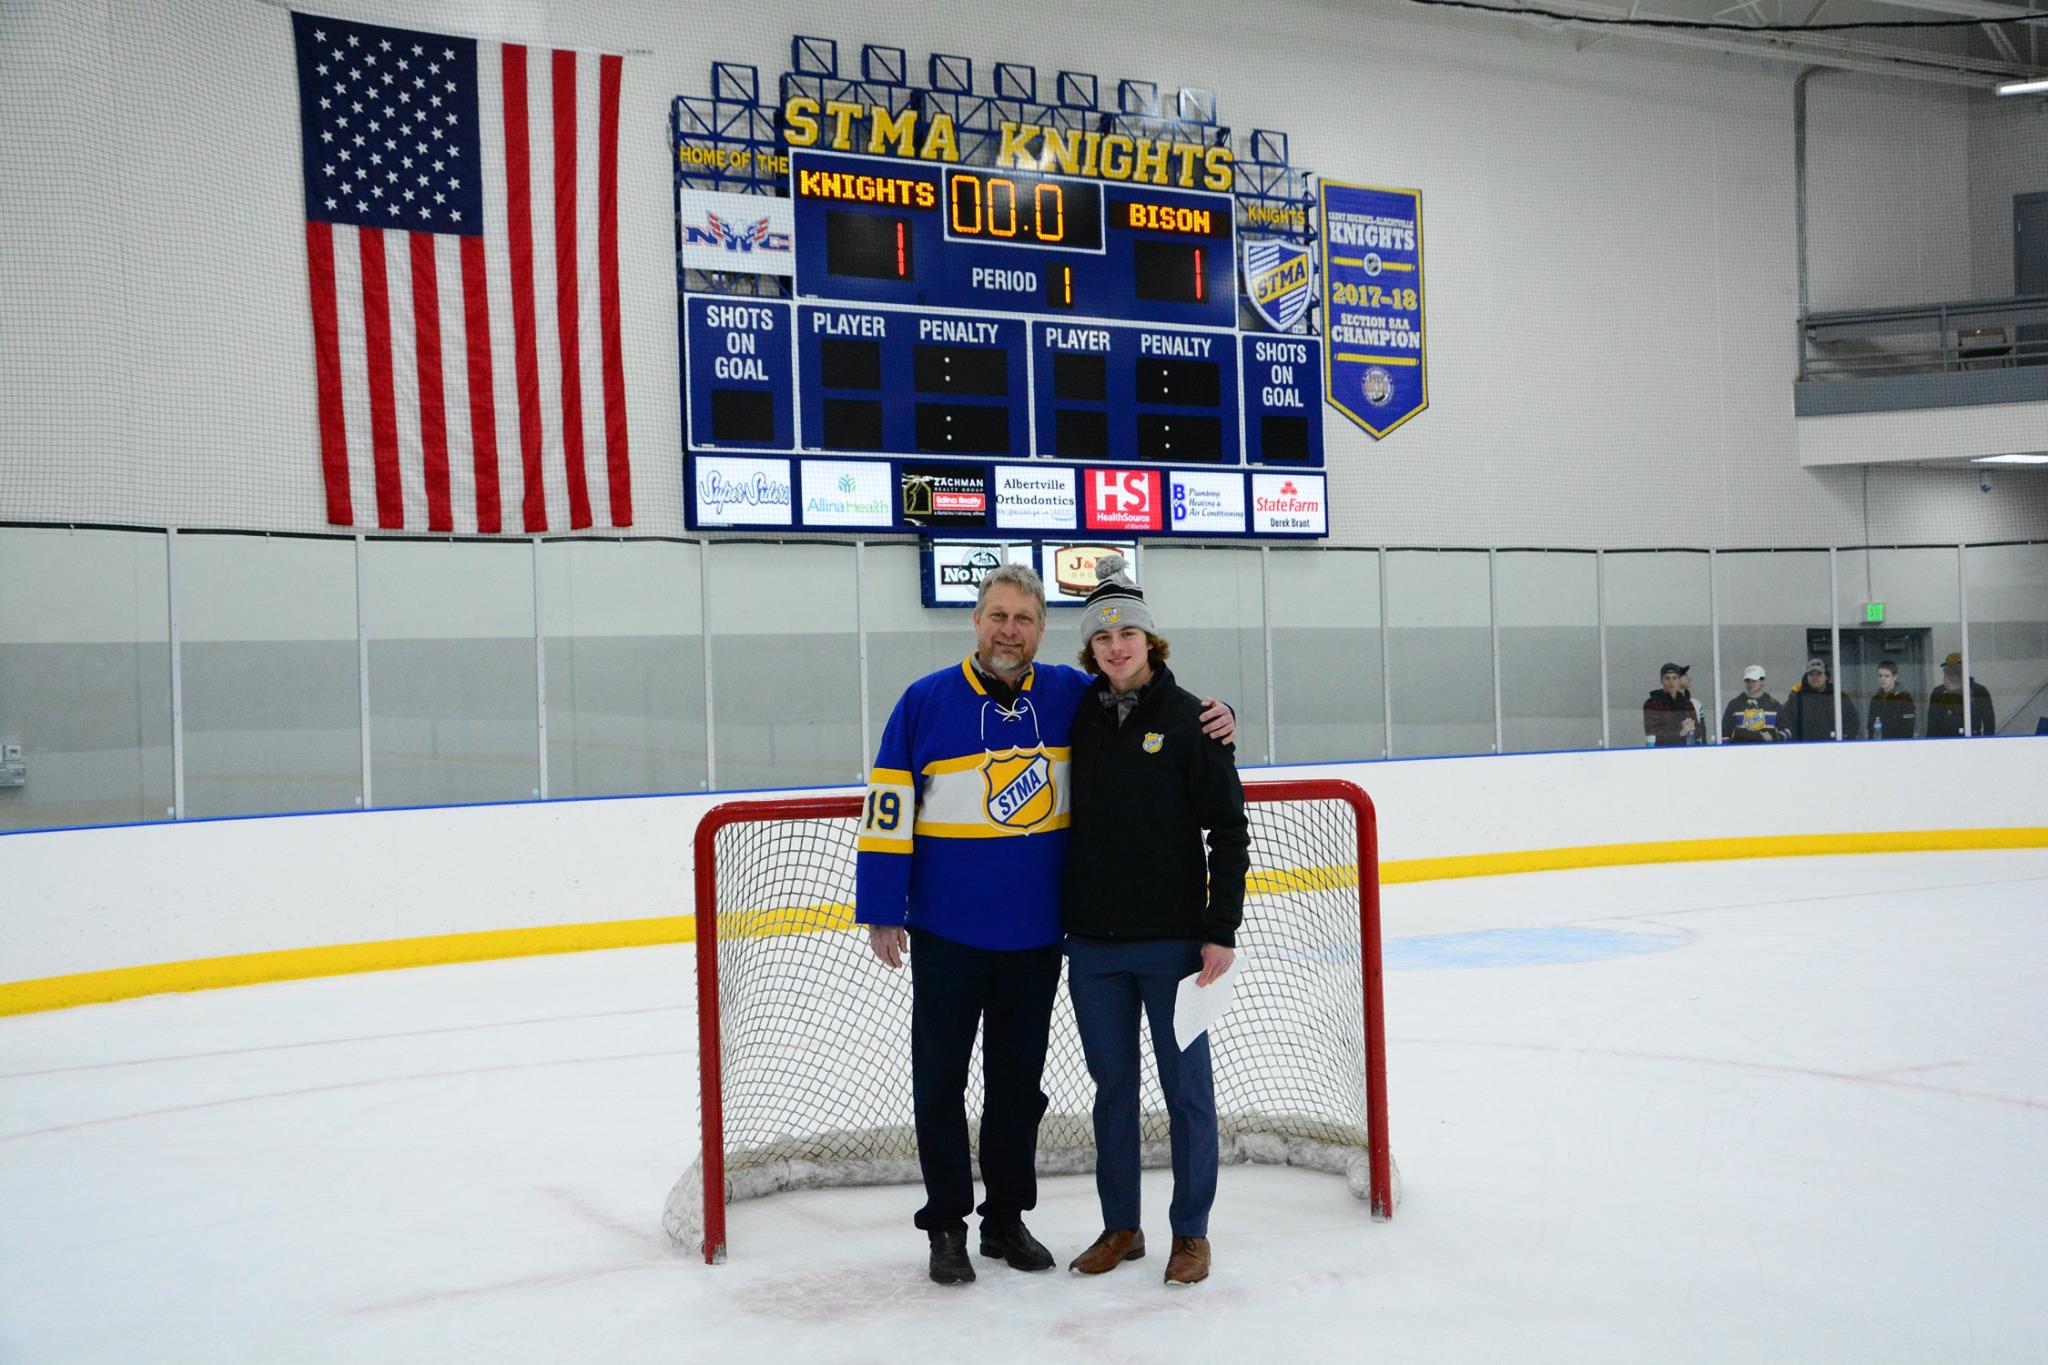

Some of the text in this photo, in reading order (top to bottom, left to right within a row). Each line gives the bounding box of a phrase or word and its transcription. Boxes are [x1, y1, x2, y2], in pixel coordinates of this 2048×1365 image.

[783, 96, 1234, 191] STMA KNIGHTS
[680, 146, 789, 174] HOME OF THE
[799, 169, 935, 207] KNIGHTS
[1129, 203, 1211, 234] BISON
[1247, 206, 1306, 225] KNIGHTS
[1328, 221, 1415, 251] KNIGHTS
[896, 221, 905, 276] 1
[972, 267, 1037, 292] PERIOD
[1063, 266, 1072, 304] 1
[1194, 249, 1202, 300] 1
[1257, 260, 1306, 299] STMA
[1332, 281, 1418, 310] 2017-18
[706, 304, 774, 331] SHOTS
[813, 312, 886, 338] PLAYER
[1340, 313, 1386, 328] SECTION
[726, 332, 755, 355] ON
[919, 319, 999, 344] PENALTY
[1045, 327, 1111, 351] PLAYER
[1331, 325, 1421, 349] CHAMPION
[1140, 334, 1212, 358] PENALTY
[1255, 341, 1307, 364] SHOTS
[715, 357, 769, 381] GOAL
[1271, 365, 1293, 385] ON
[1262, 386, 1304, 407] GOAL
[934, 478, 984, 487] ZACHMAN
[1004, 479, 1065, 490] Albertville
[1096, 471, 1149, 511] HS
[1188, 488, 1221, 498] Plumbing
[807, 498, 888, 513] Allina Health
[996, 494, 1074, 505] Orthodontics
[1256, 497, 1319, 513] State Farm
[1096, 511, 1150, 522] HealthSource
[1270, 518, 1290, 528] Derek
[998, 768, 1042, 816] STMA
[865, 790, 901, 831] 19
